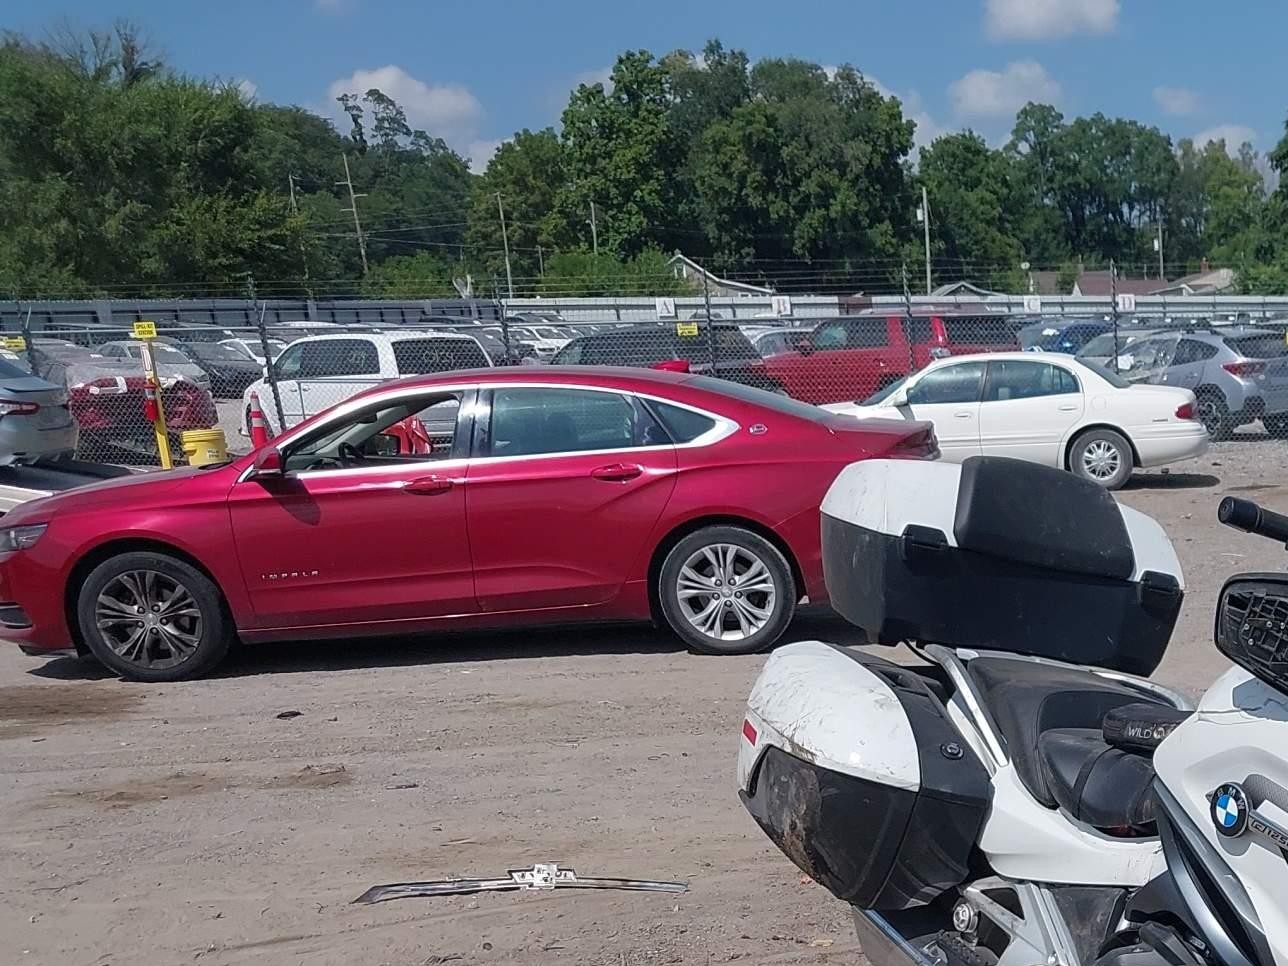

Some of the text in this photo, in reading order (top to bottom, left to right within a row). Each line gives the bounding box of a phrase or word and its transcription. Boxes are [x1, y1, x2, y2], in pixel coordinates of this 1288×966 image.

[661, 299, 672, 314] A
[1127, 727, 1152, 739] WILD
[1216, 786, 1246, 810] BMW
